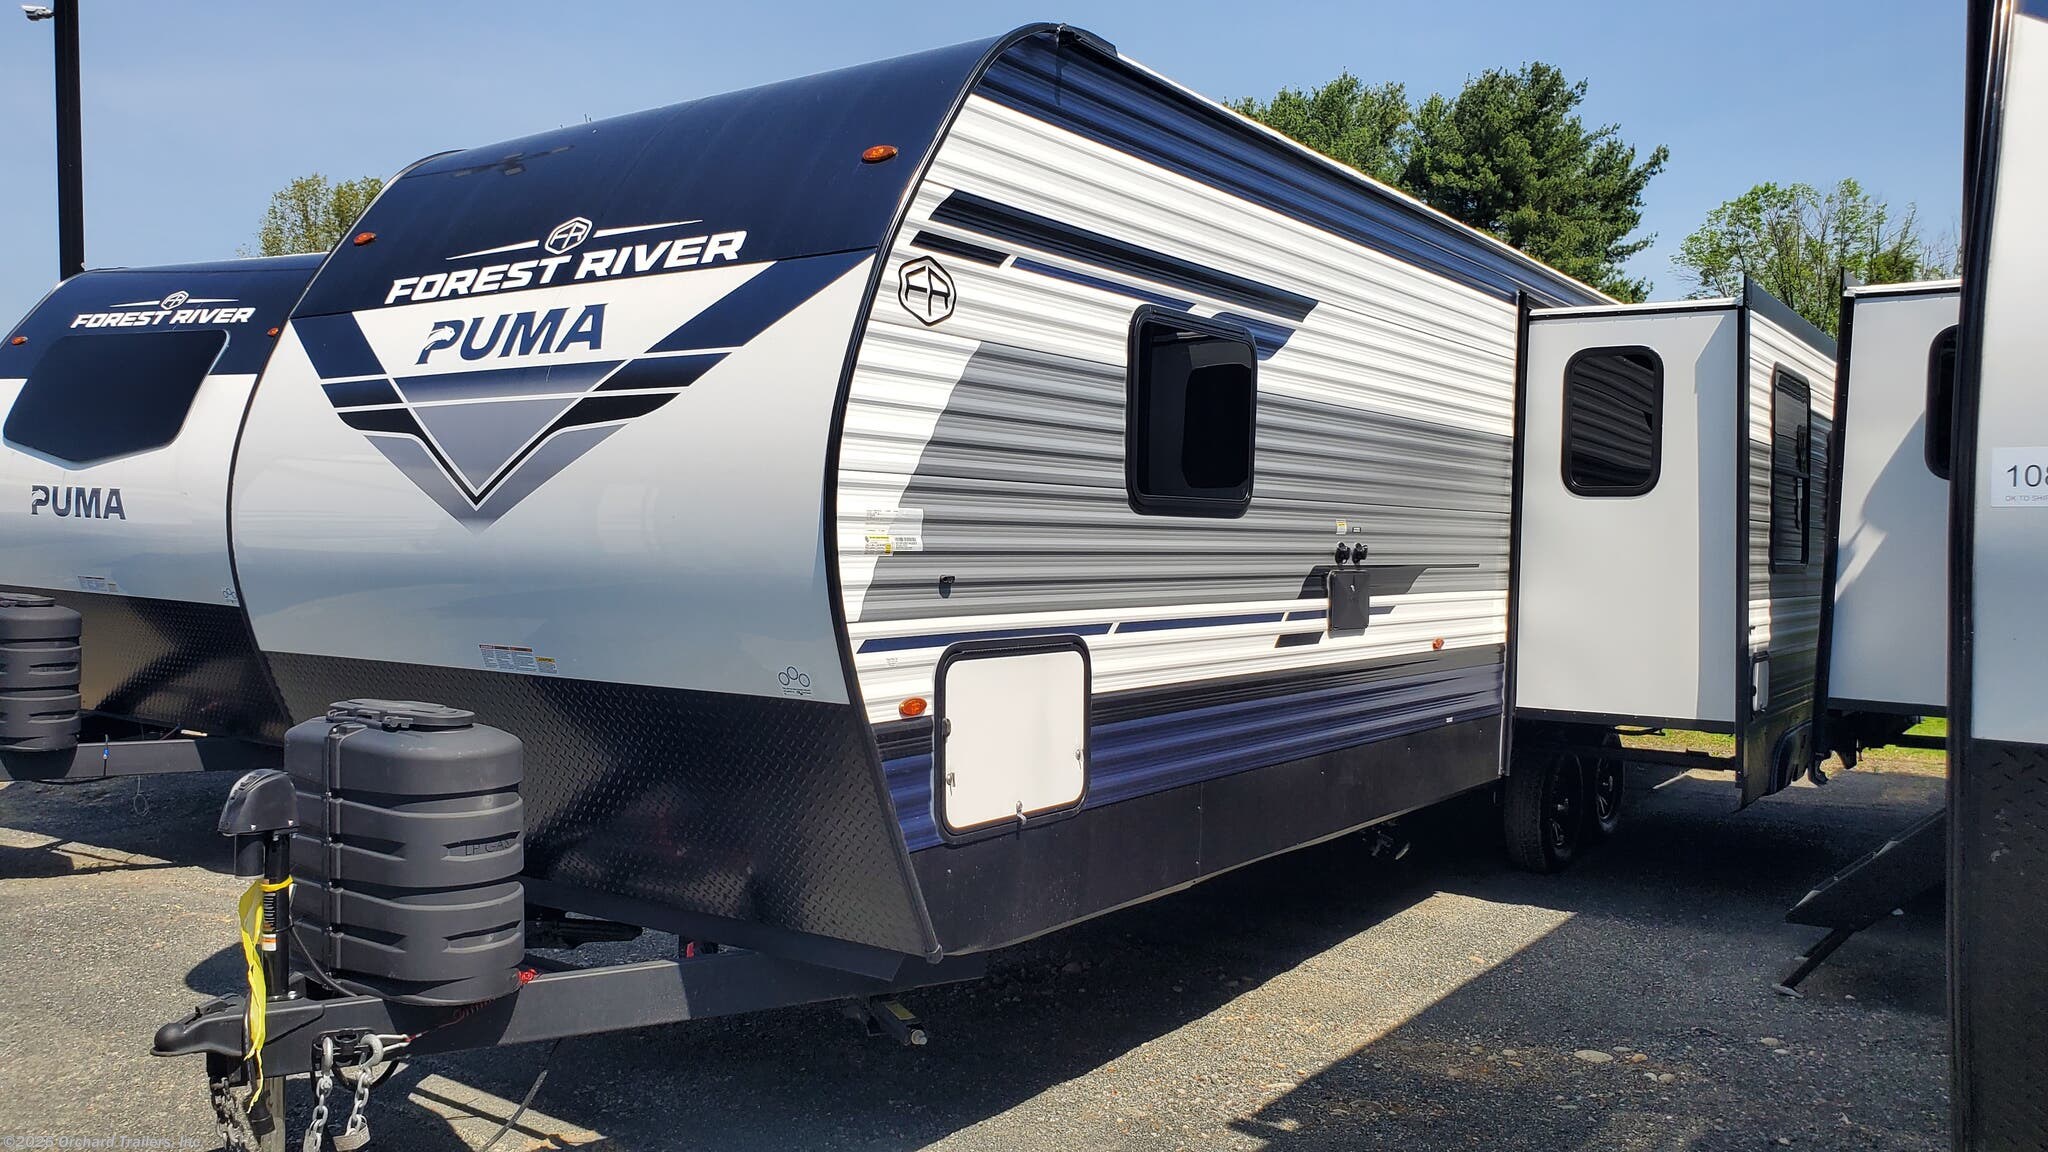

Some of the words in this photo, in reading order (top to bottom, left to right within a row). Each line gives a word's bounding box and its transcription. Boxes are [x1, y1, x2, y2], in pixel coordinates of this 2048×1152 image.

[384, 255, 572, 305] FOREST
[574, 230, 748, 280] RIVER
[70, 310, 173, 329] FOREST
[169, 307, 256, 325] RIVER
[415, 303, 608, 365] PUMA
[2007, 464, 2048, 488] 10
[31, 485, 127, 520] PUMA
